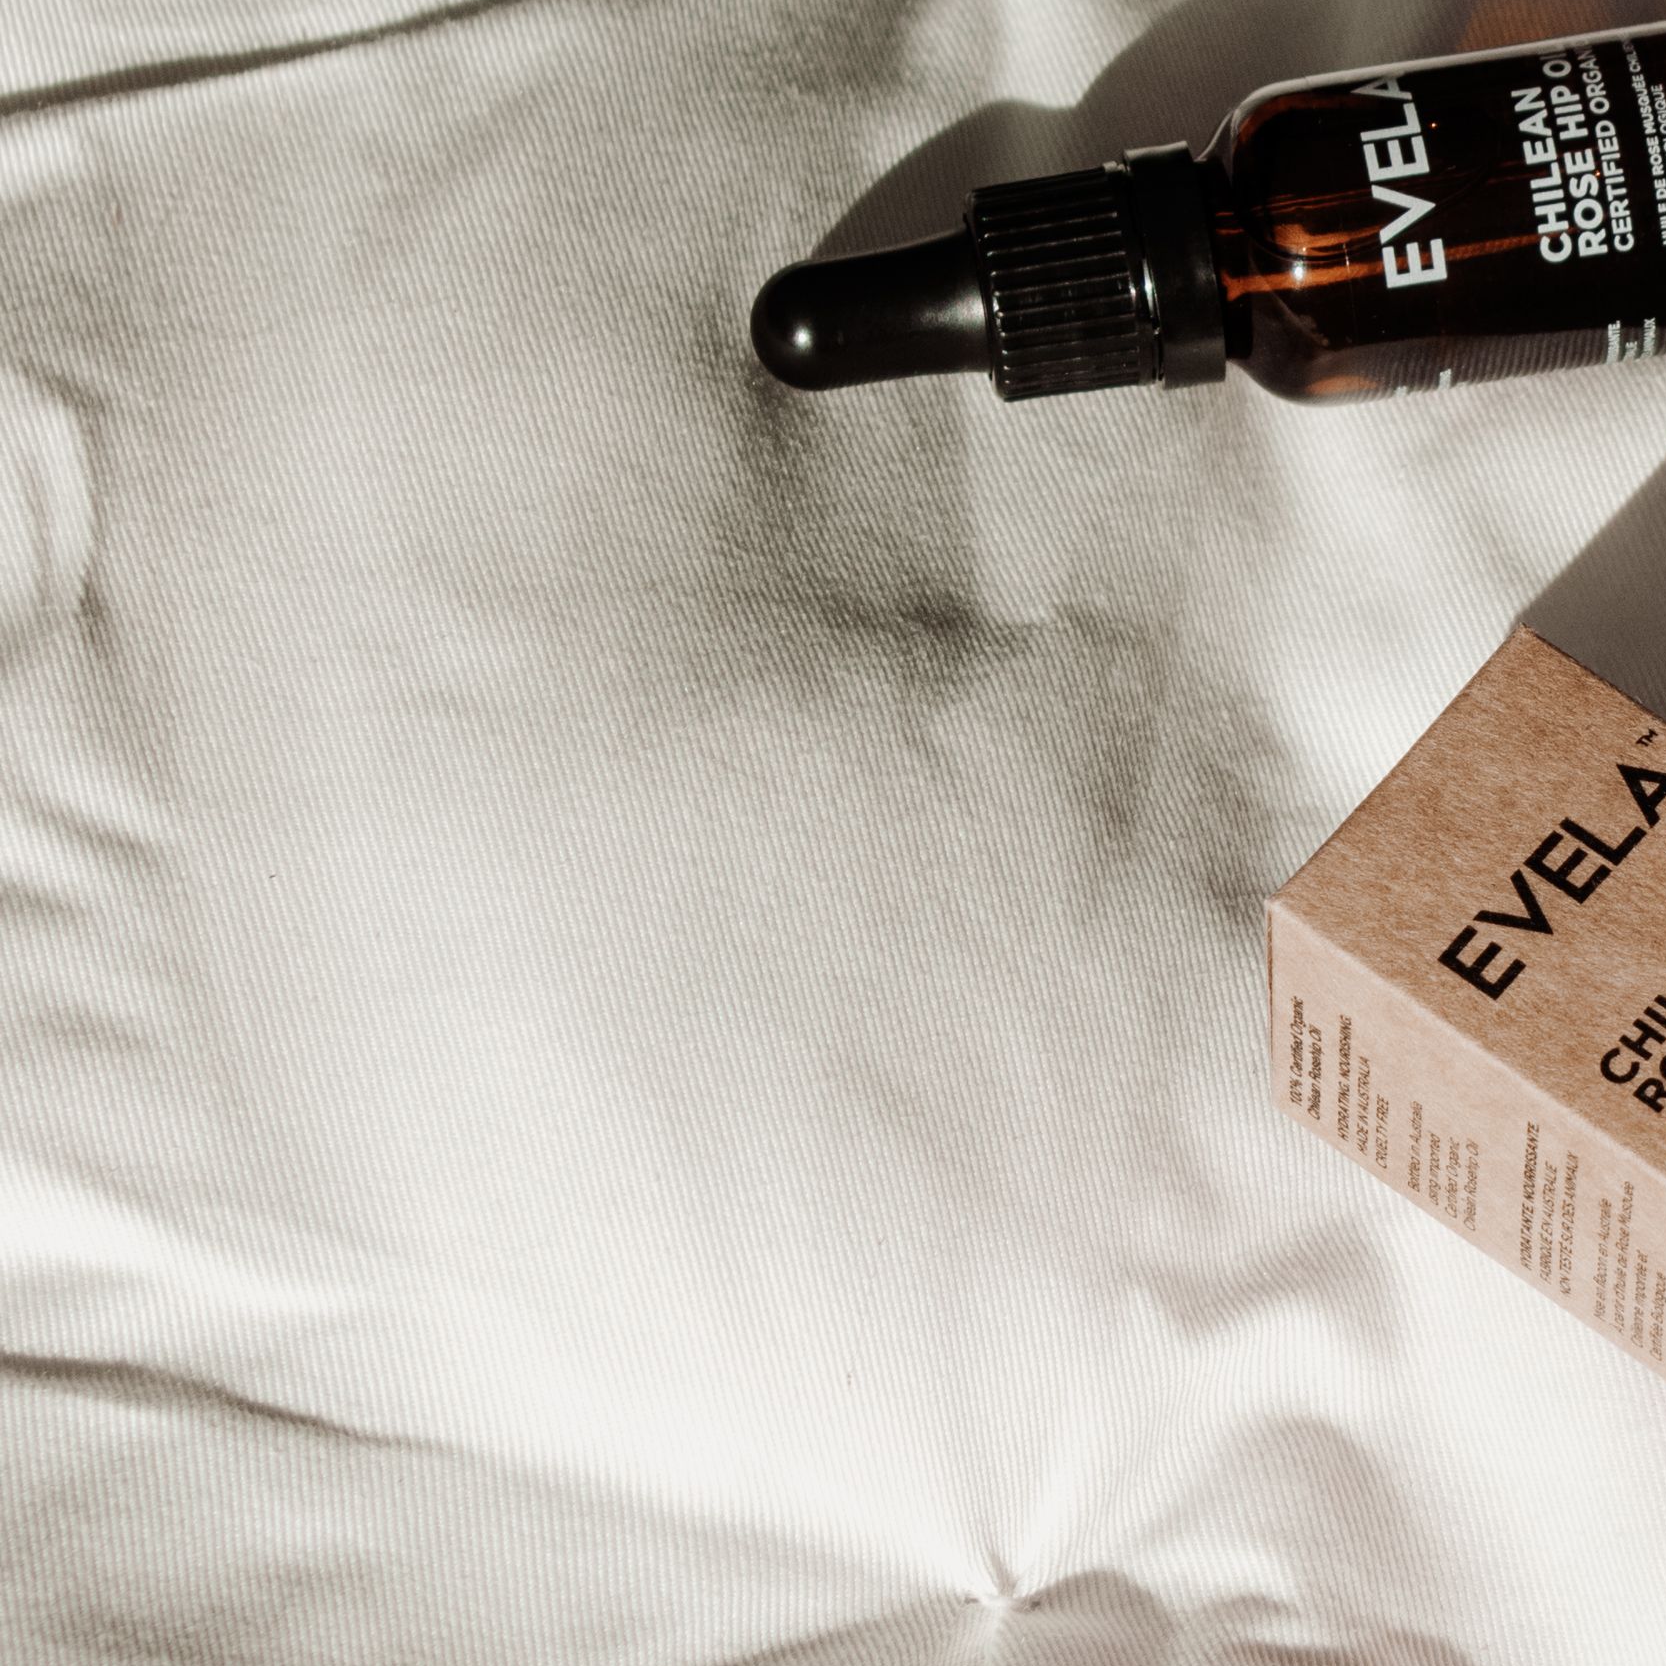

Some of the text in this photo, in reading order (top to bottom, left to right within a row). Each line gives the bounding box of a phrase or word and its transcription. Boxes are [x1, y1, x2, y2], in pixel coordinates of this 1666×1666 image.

[1550, 85, 1589, 141] HIP
[1574, 46, 1635, 252] CERTIFIED ORGAN
[1632, 73, 1656, 135] MUSQUÉE
[1646, 135, 1665, 176] ROSE
[1350, 75, 1448, 289] EVELA
[1511, 86, 1572, 262] CHILEAN
[1563, 148, 1608, 257] ROSE
